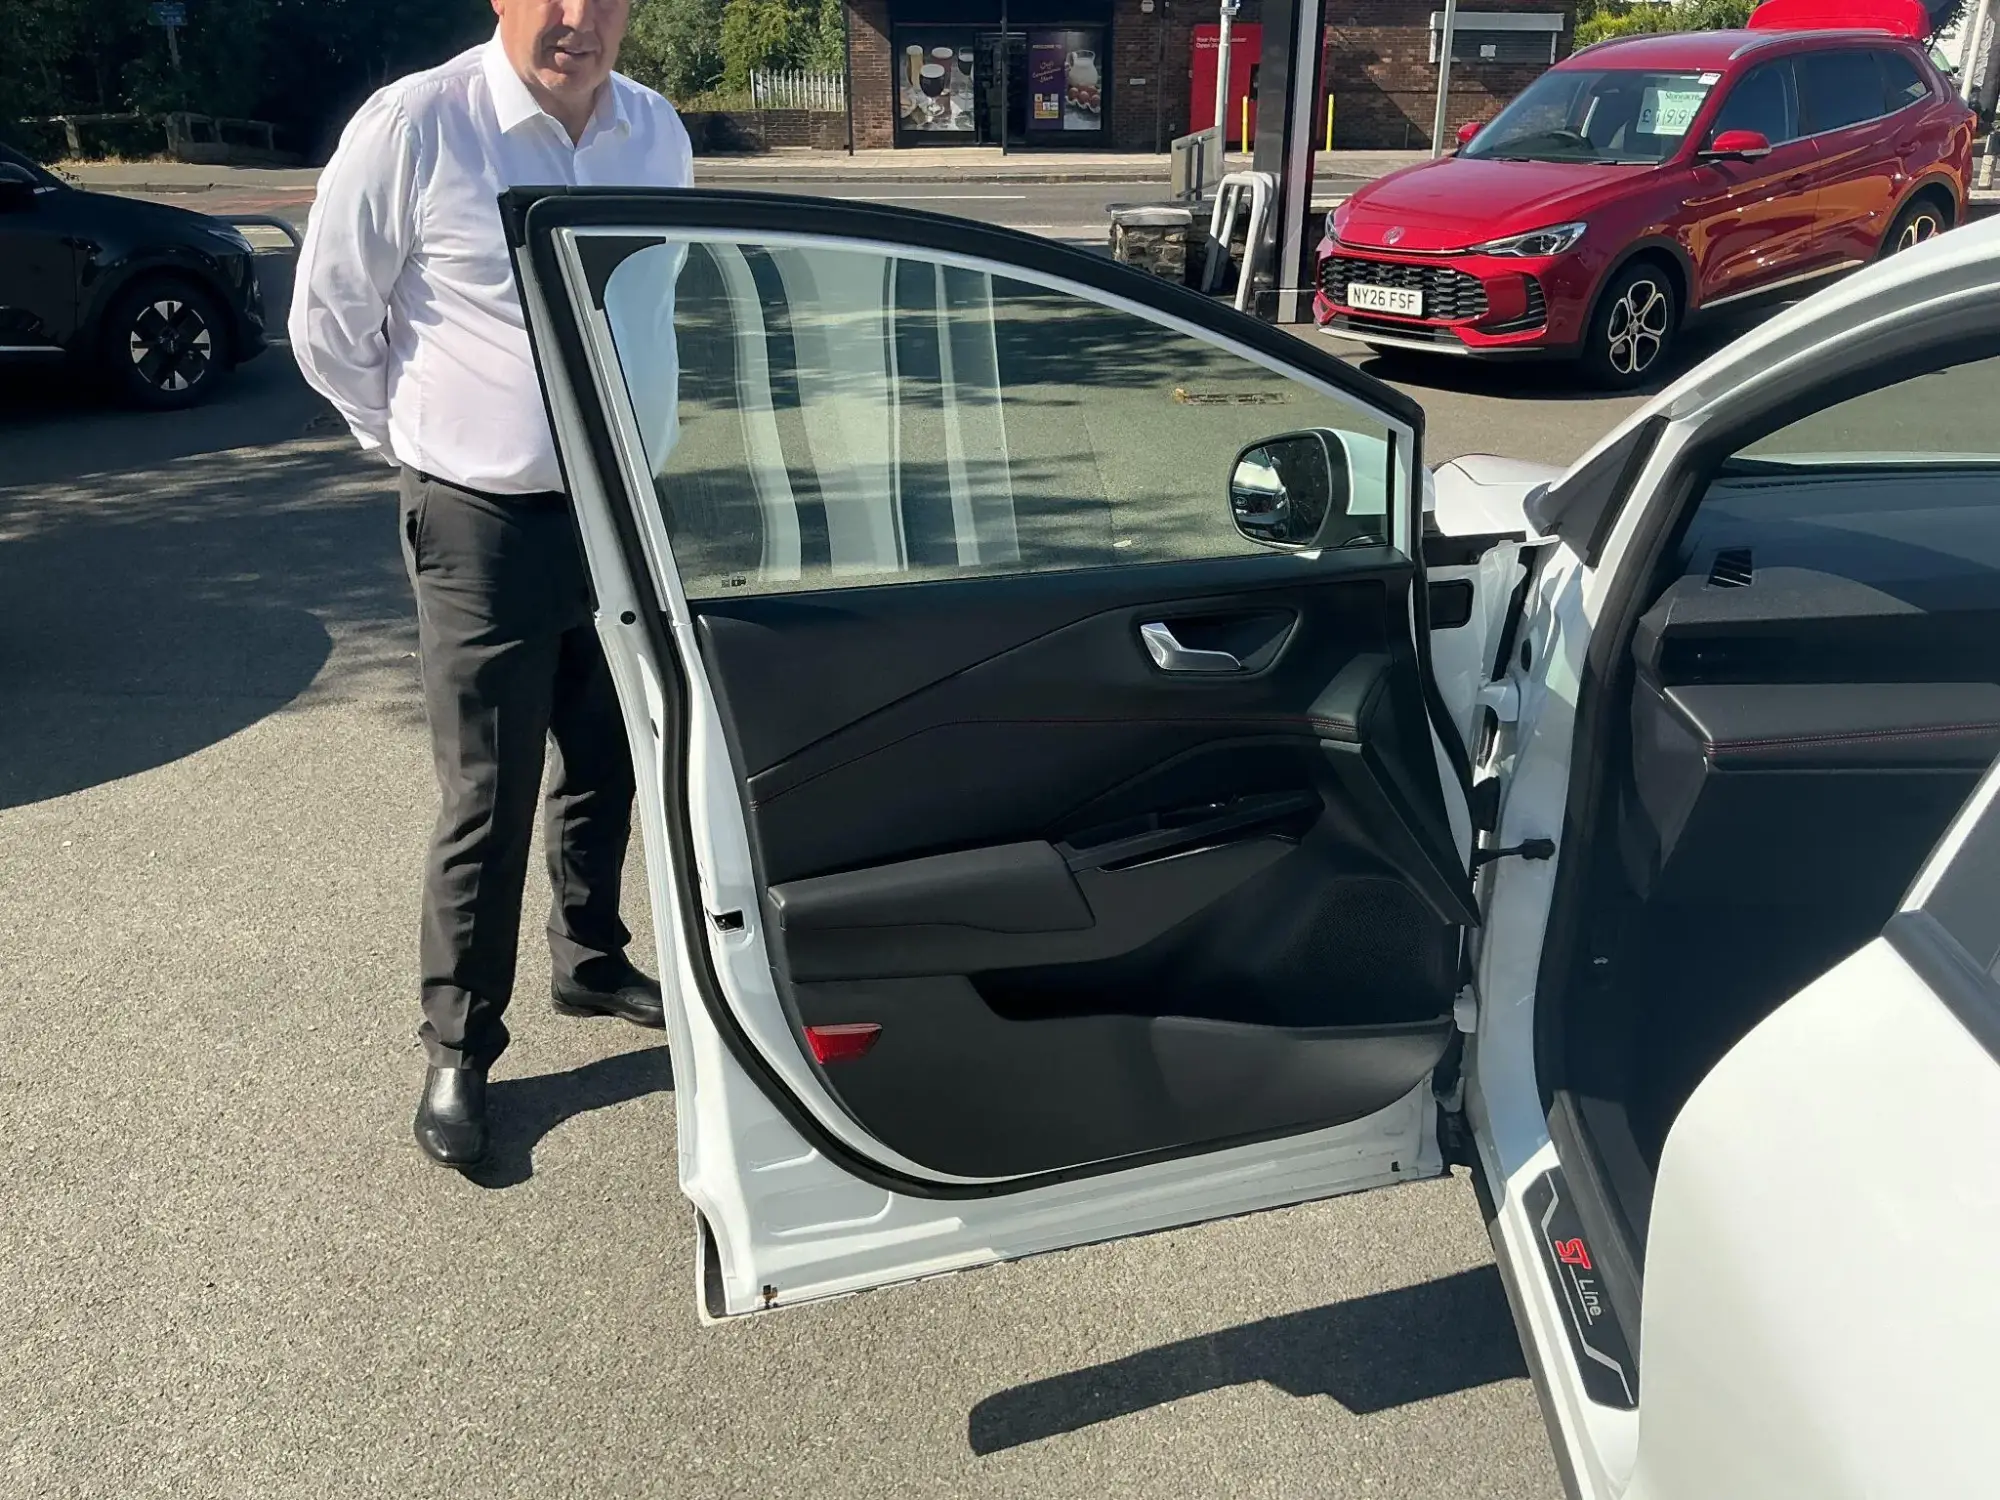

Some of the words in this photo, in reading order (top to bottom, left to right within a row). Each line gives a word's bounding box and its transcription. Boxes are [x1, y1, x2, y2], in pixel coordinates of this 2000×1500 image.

[1353, 287, 1386, 306] NY26
[1389, 291, 1416, 310] FSF
[1555, 1238, 1592, 1269] ST
[1579, 1279, 1602, 1317] Line
